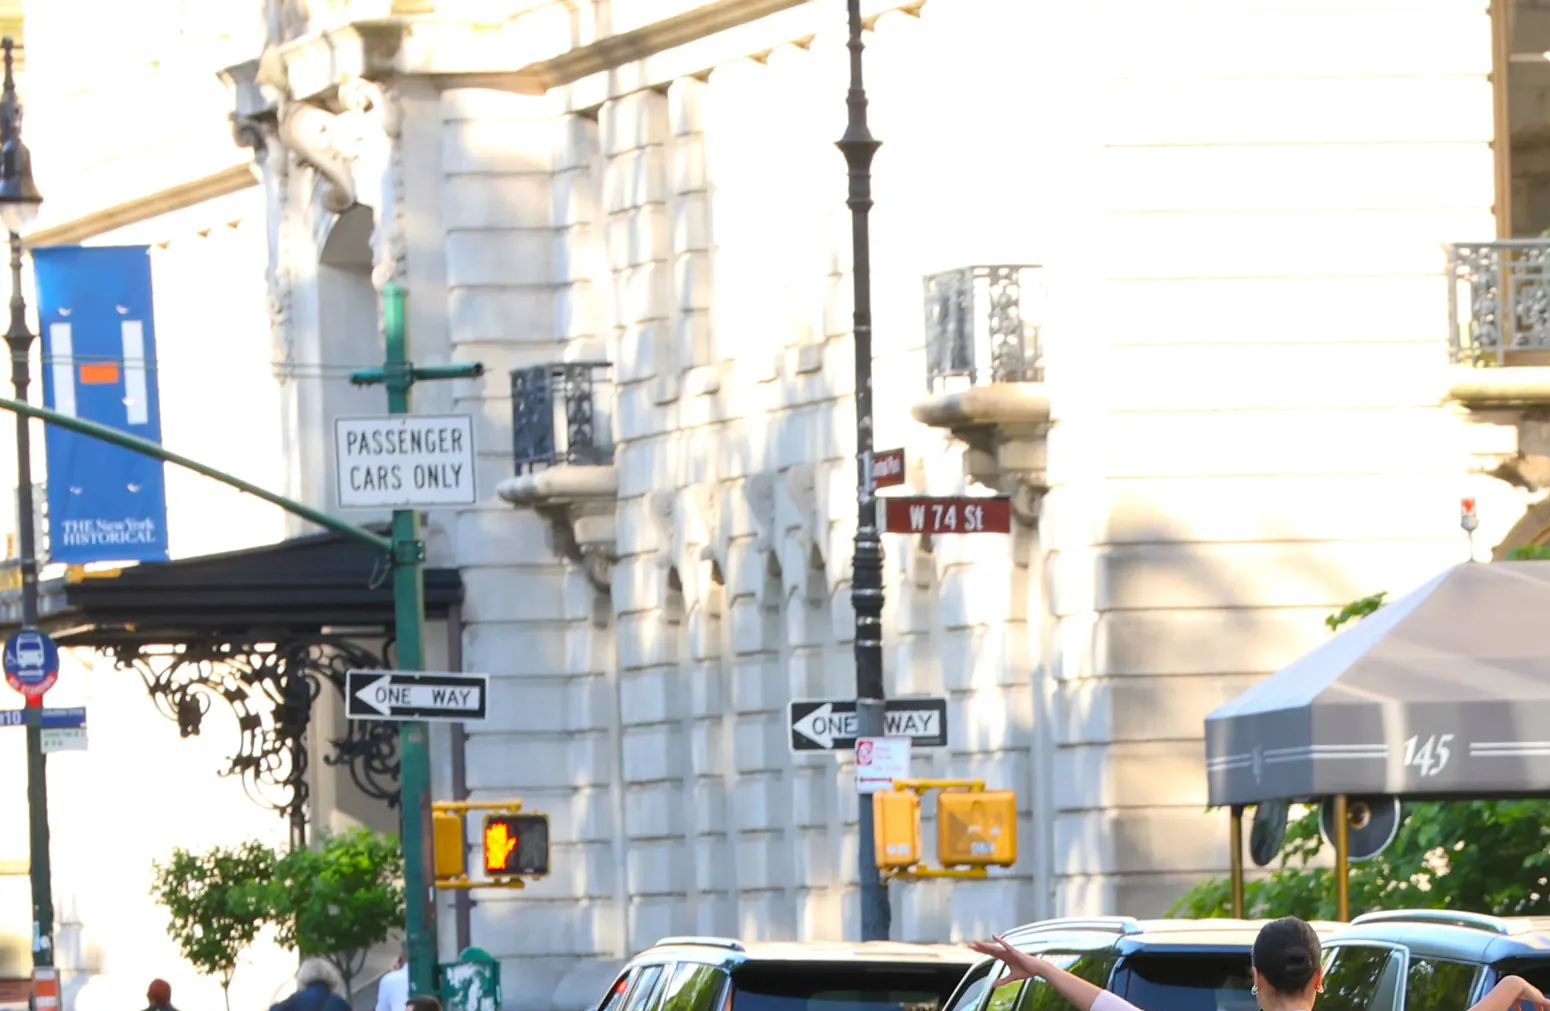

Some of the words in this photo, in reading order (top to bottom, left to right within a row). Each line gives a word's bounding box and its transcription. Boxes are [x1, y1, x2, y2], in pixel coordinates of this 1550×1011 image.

[346, 428, 463, 456] PASSENGER
[350, 464, 403, 491] CARS
[413, 462, 463, 490] ONLY
[62, 519, 93, 533] THE
[909, 504, 926, 531] W
[932, 504, 957, 531] 74
[964, 504, 984, 531] St
[63, 530, 156, 546] HISTORICAL
[375, 686, 412, 705] ONE
[432, 688, 471, 706] WAY
[812, 715, 858, 735] ONE
[884, 713, 933, 733] WAY
[1403, 733, 1455, 778] 145
